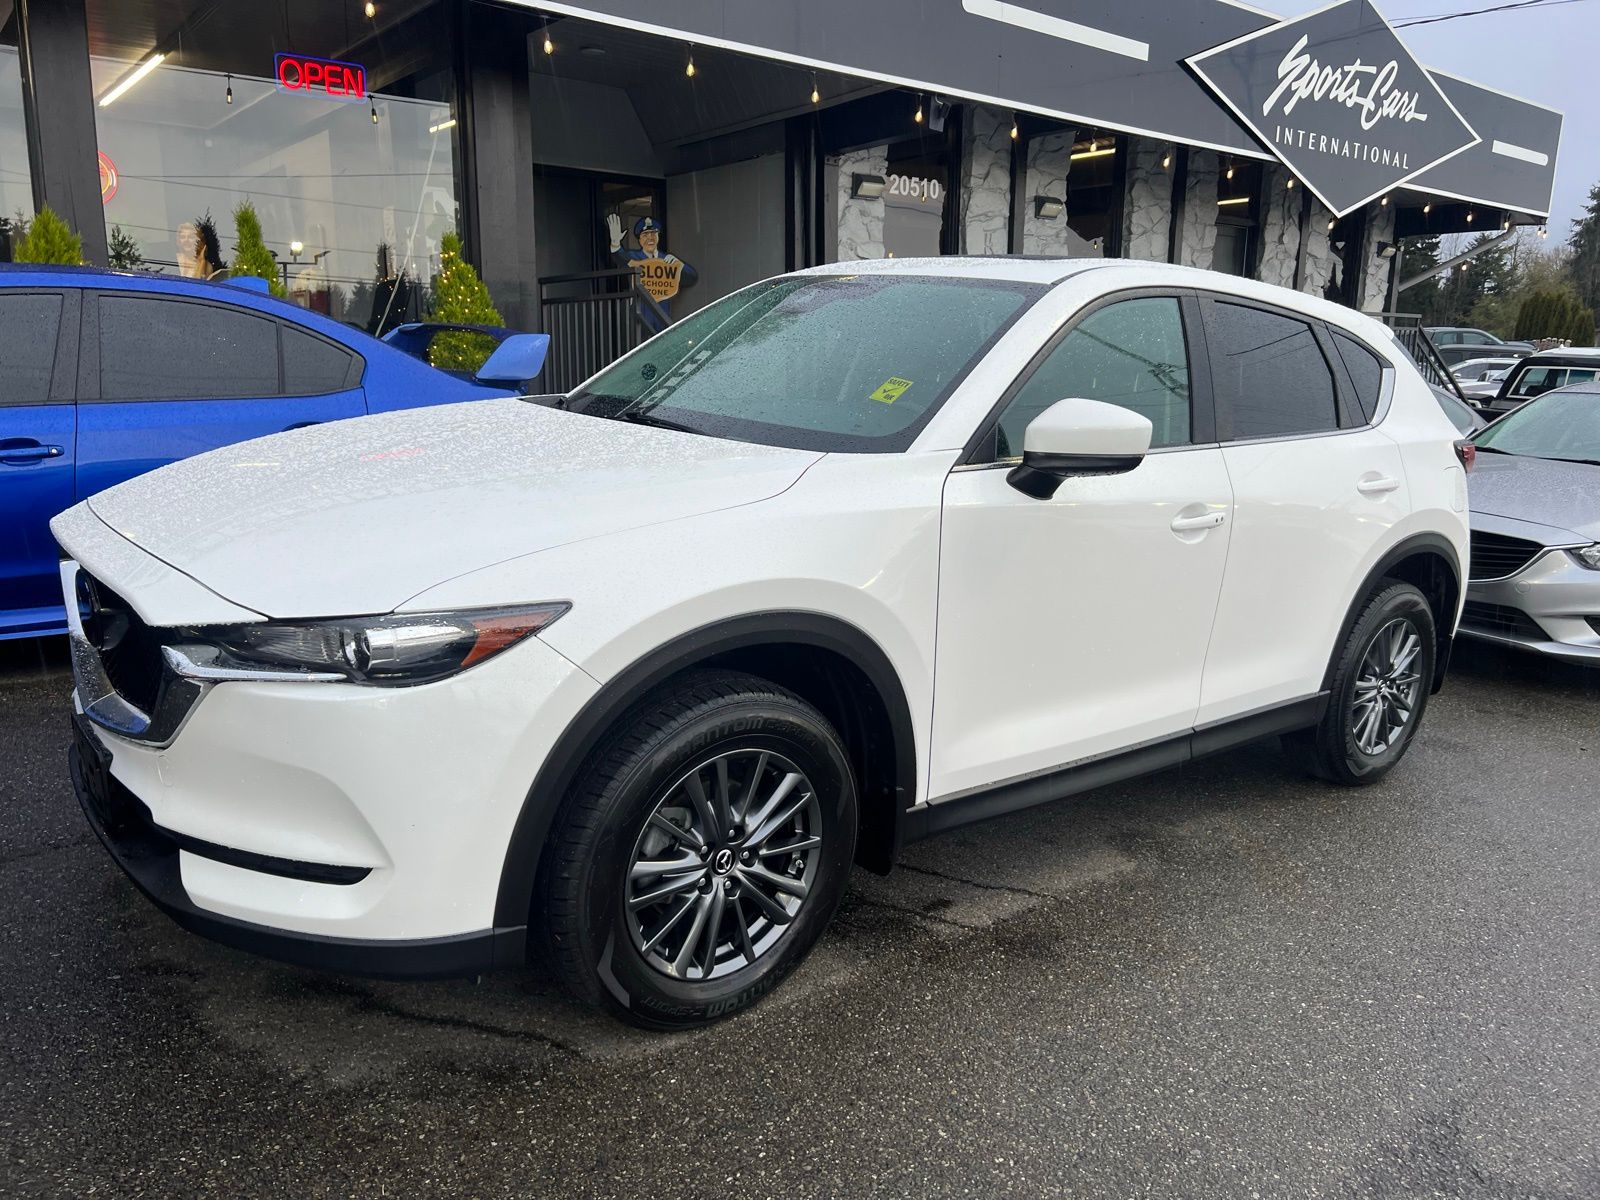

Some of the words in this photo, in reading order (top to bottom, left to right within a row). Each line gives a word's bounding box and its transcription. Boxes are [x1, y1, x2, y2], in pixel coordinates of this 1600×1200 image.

[279, 58, 363, 98] OPEN
[1262, 33, 1377, 117] Sports
[1357, 60, 1427, 131] Cars
[1275, 125, 1409, 170] INTERNATIONAL
[889, 174, 939, 199] 20510
[639, 265, 678, 279] SLOW
[641, 280, 674, 288] SCHOOL
